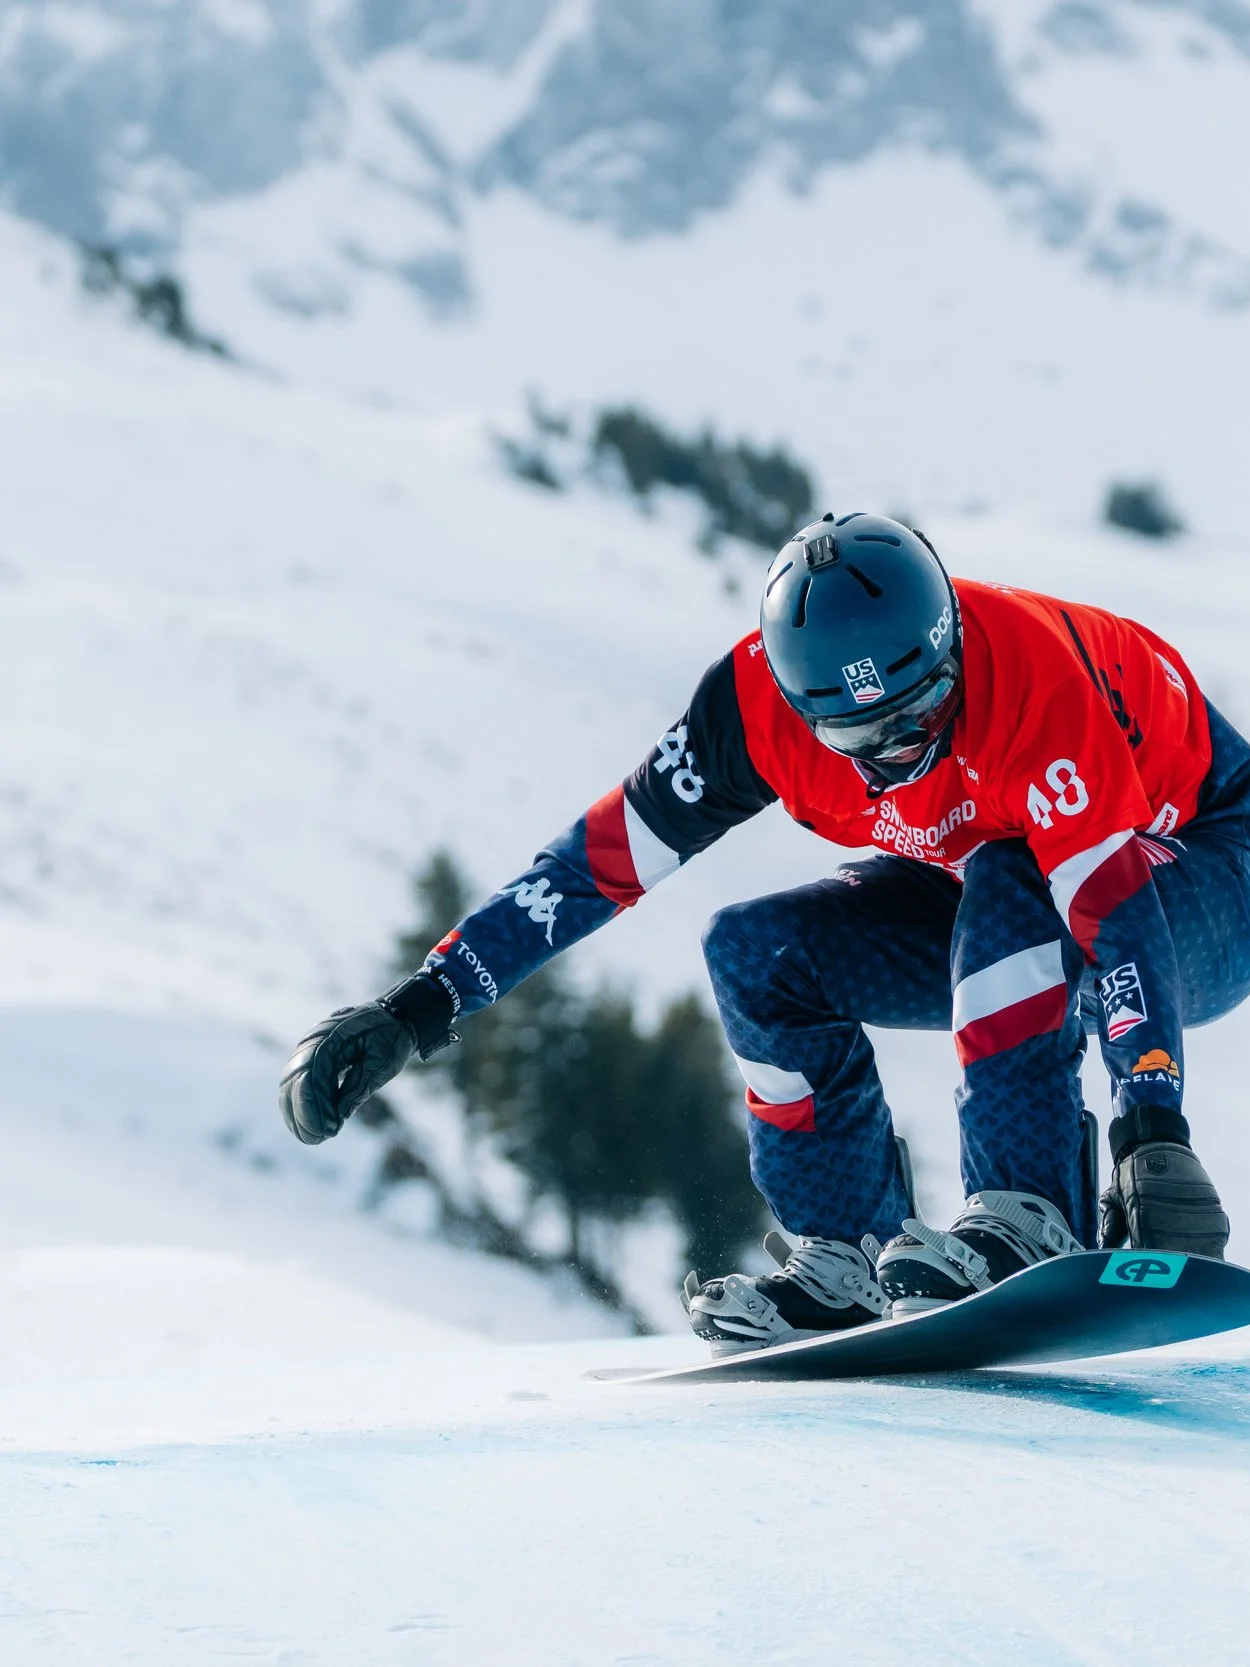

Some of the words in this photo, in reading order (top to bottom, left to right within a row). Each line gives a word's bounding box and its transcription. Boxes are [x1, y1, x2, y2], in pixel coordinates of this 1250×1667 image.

[844, 660, 874, 680] US
[1027, 758, 1089, 830] 48
[871, 819, 925, 859] SPEED
[924, 847, 946, 858] TOUR
[457, 941, 498, 1004] TOYOTA
[438, 973, 461, 1014] HESTRA
